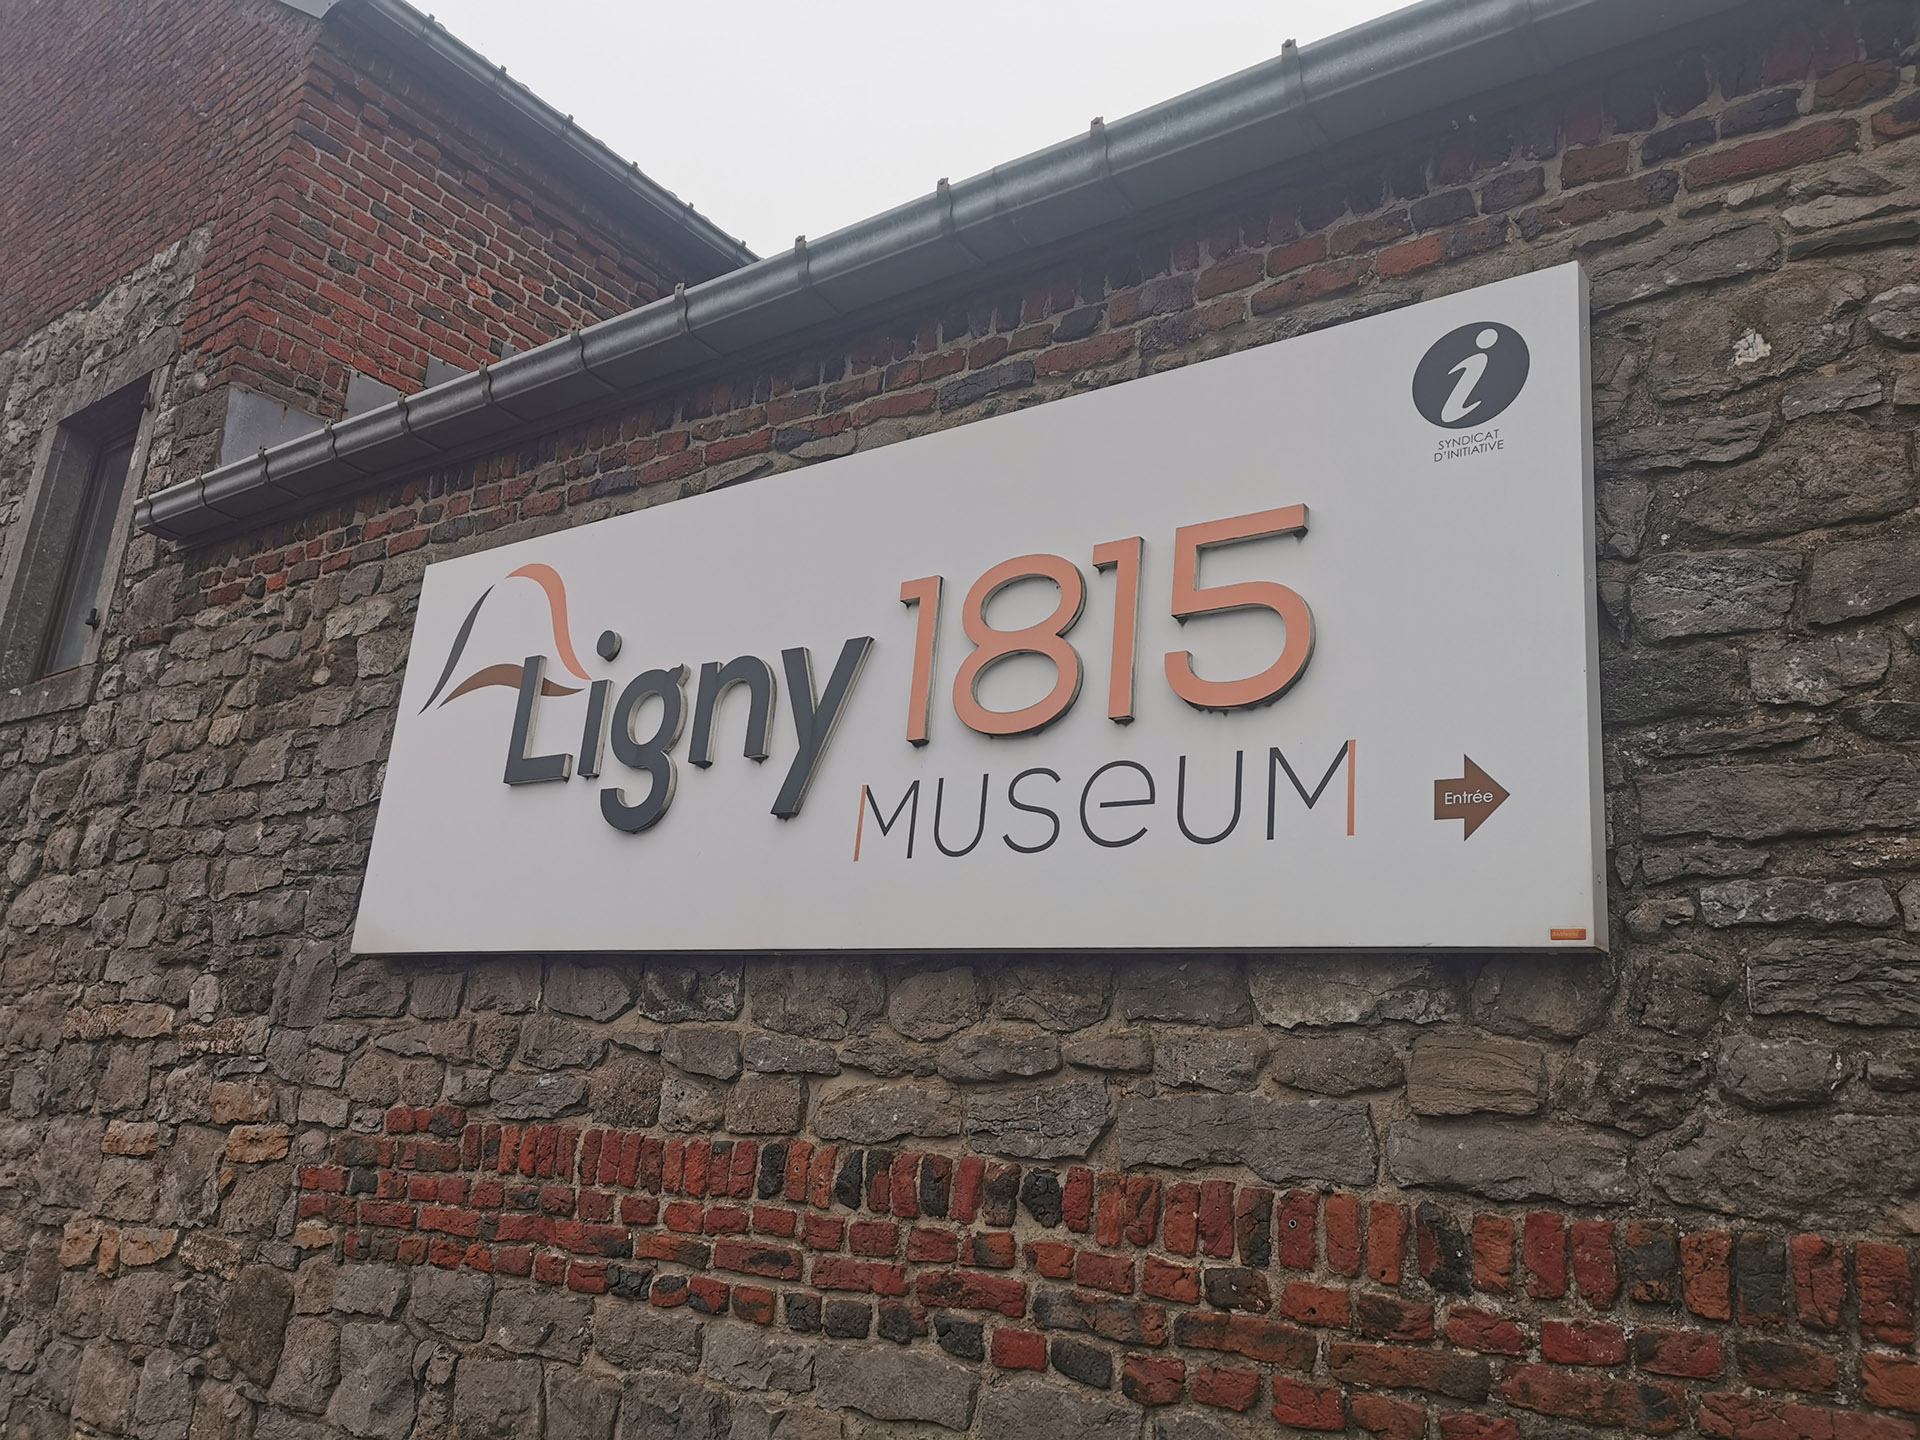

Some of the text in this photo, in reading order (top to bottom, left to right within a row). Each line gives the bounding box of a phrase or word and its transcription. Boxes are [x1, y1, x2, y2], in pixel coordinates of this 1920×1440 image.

[1438, 428, 1500, 450] SYNDICAT
[1433, 439, 1505, 463] D'INITIATIVE
[503, 503, 1317, 833] Ligny 1815
[1444, 789, 1494, 805] Entrée
